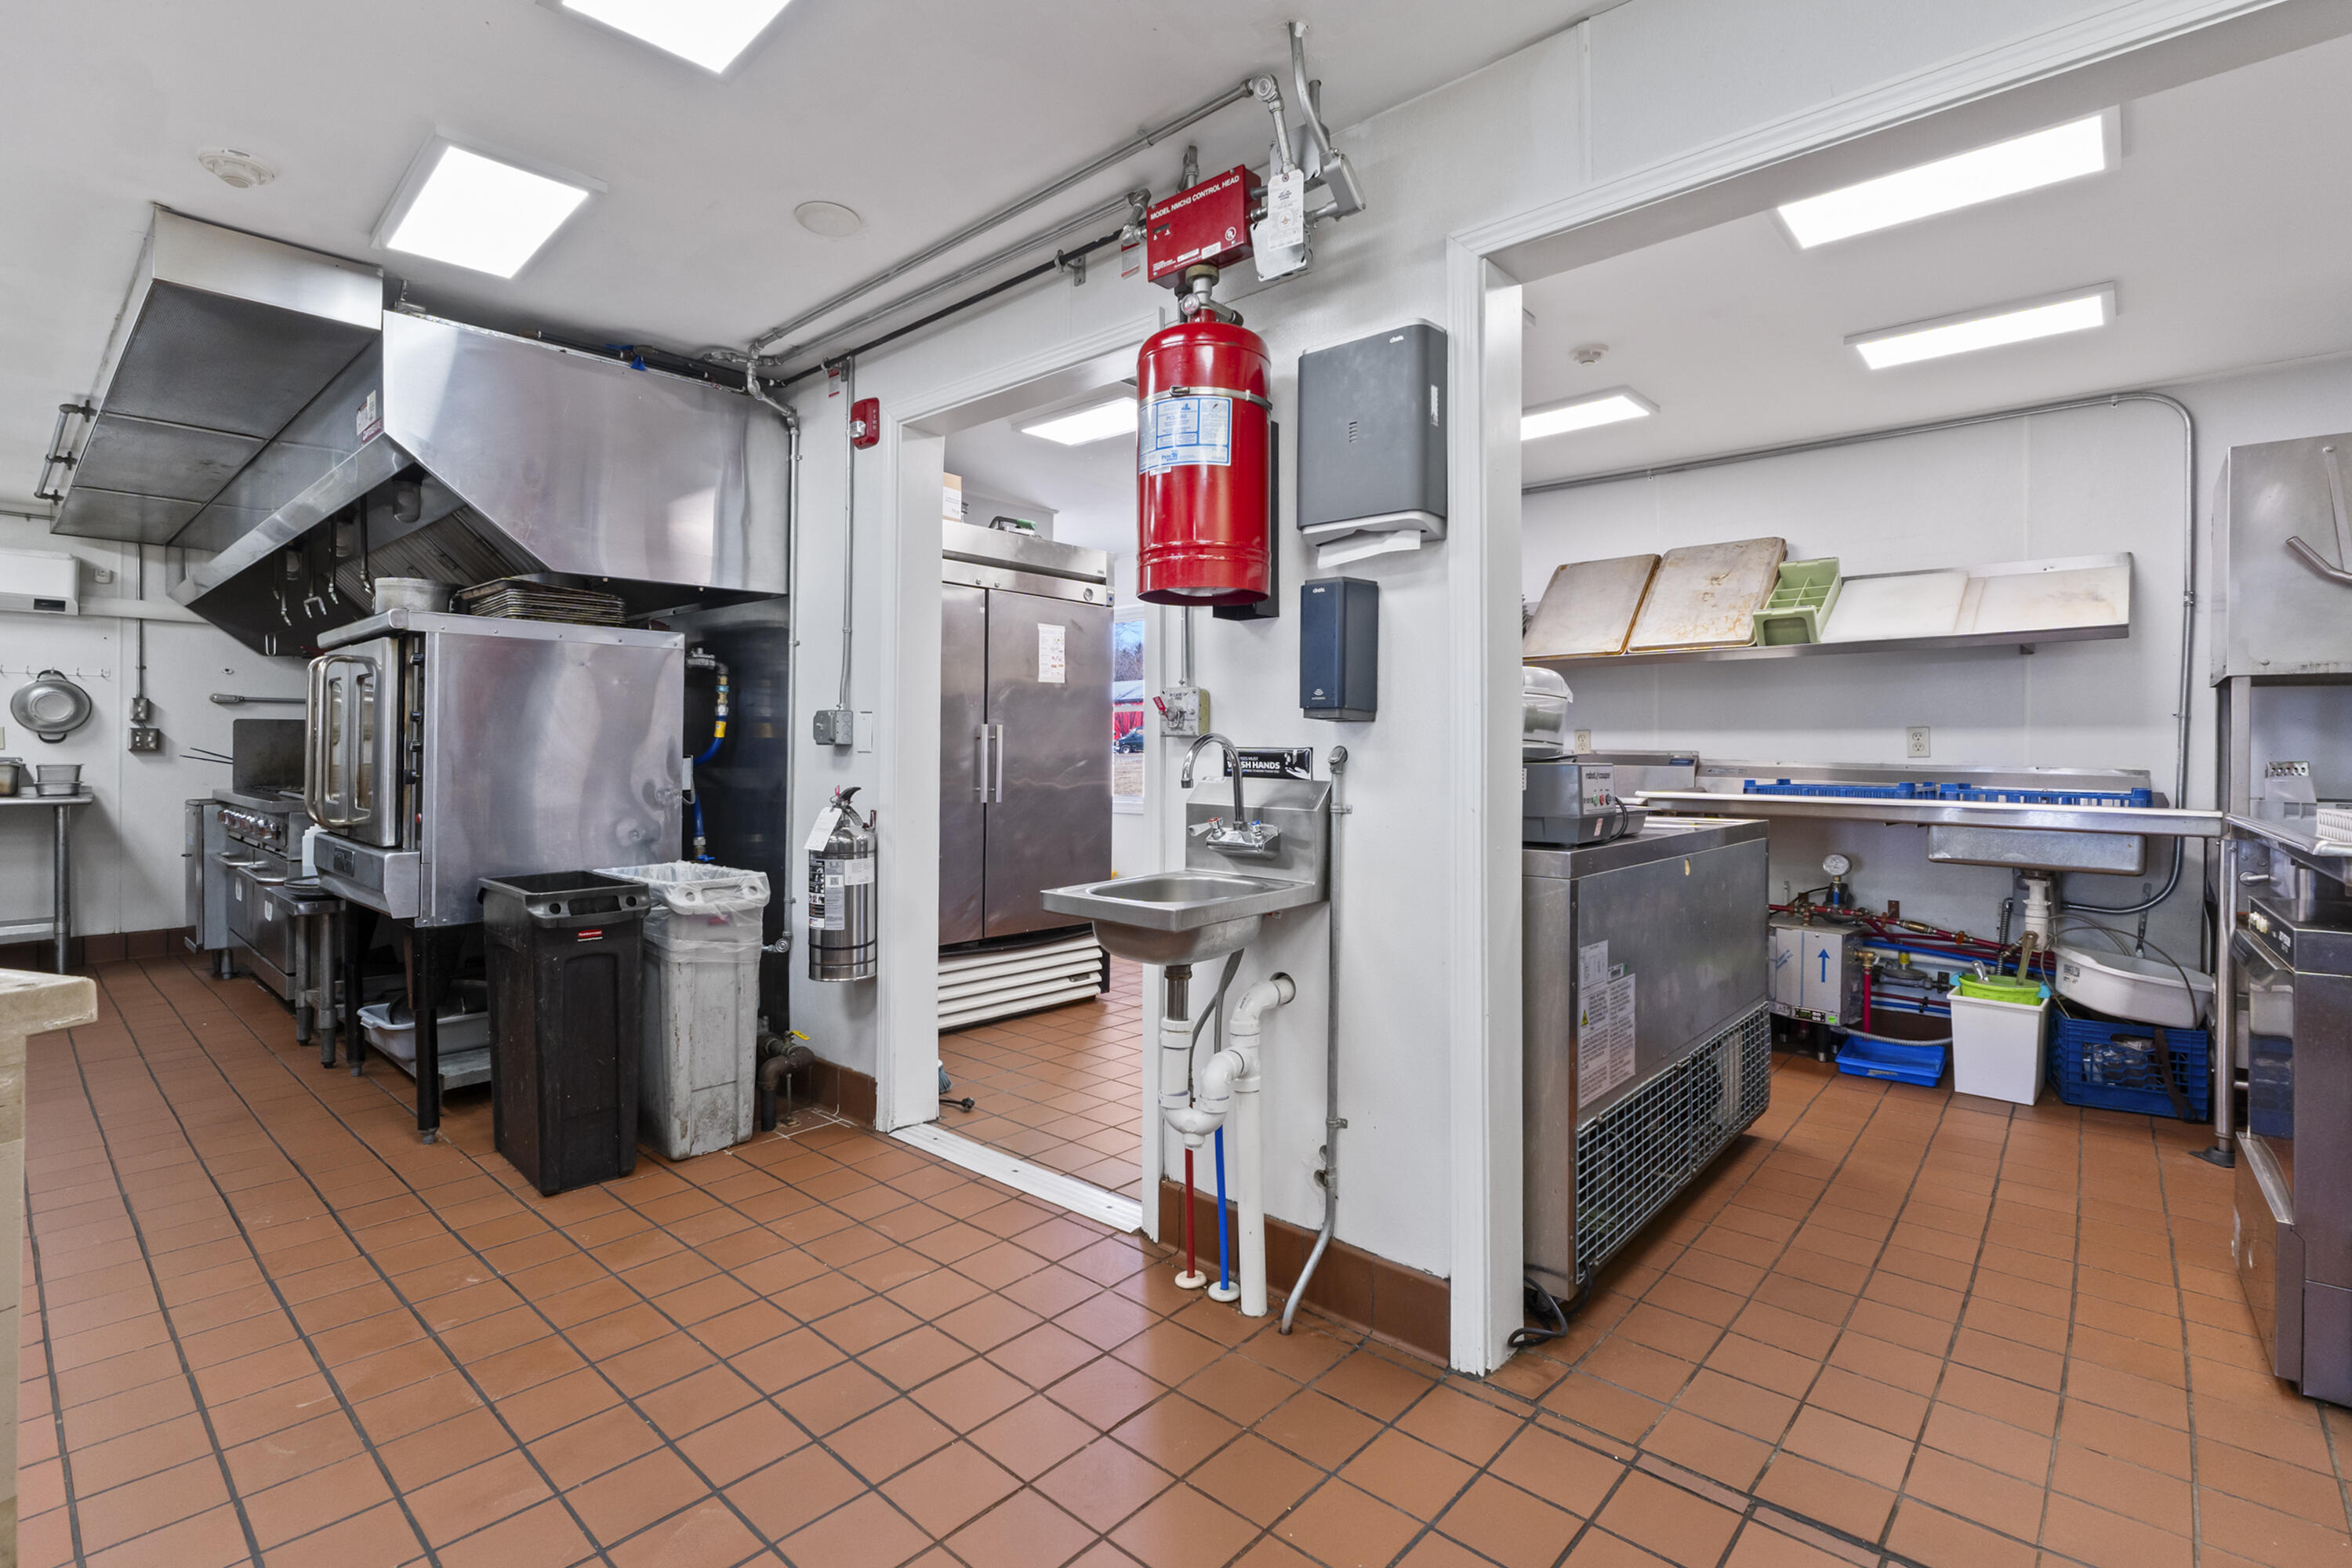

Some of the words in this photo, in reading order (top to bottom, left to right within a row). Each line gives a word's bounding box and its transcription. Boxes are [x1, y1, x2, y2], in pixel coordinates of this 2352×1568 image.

[1150, 206, 1171, 220] MODEL
[1171, 196, 1192, 212] NMCH3
[1192, 183, 1221, 201] CONTROL
[1221, 175, 1240, 189] HEAD
[1252, 761, 1280, 770] HANDS
